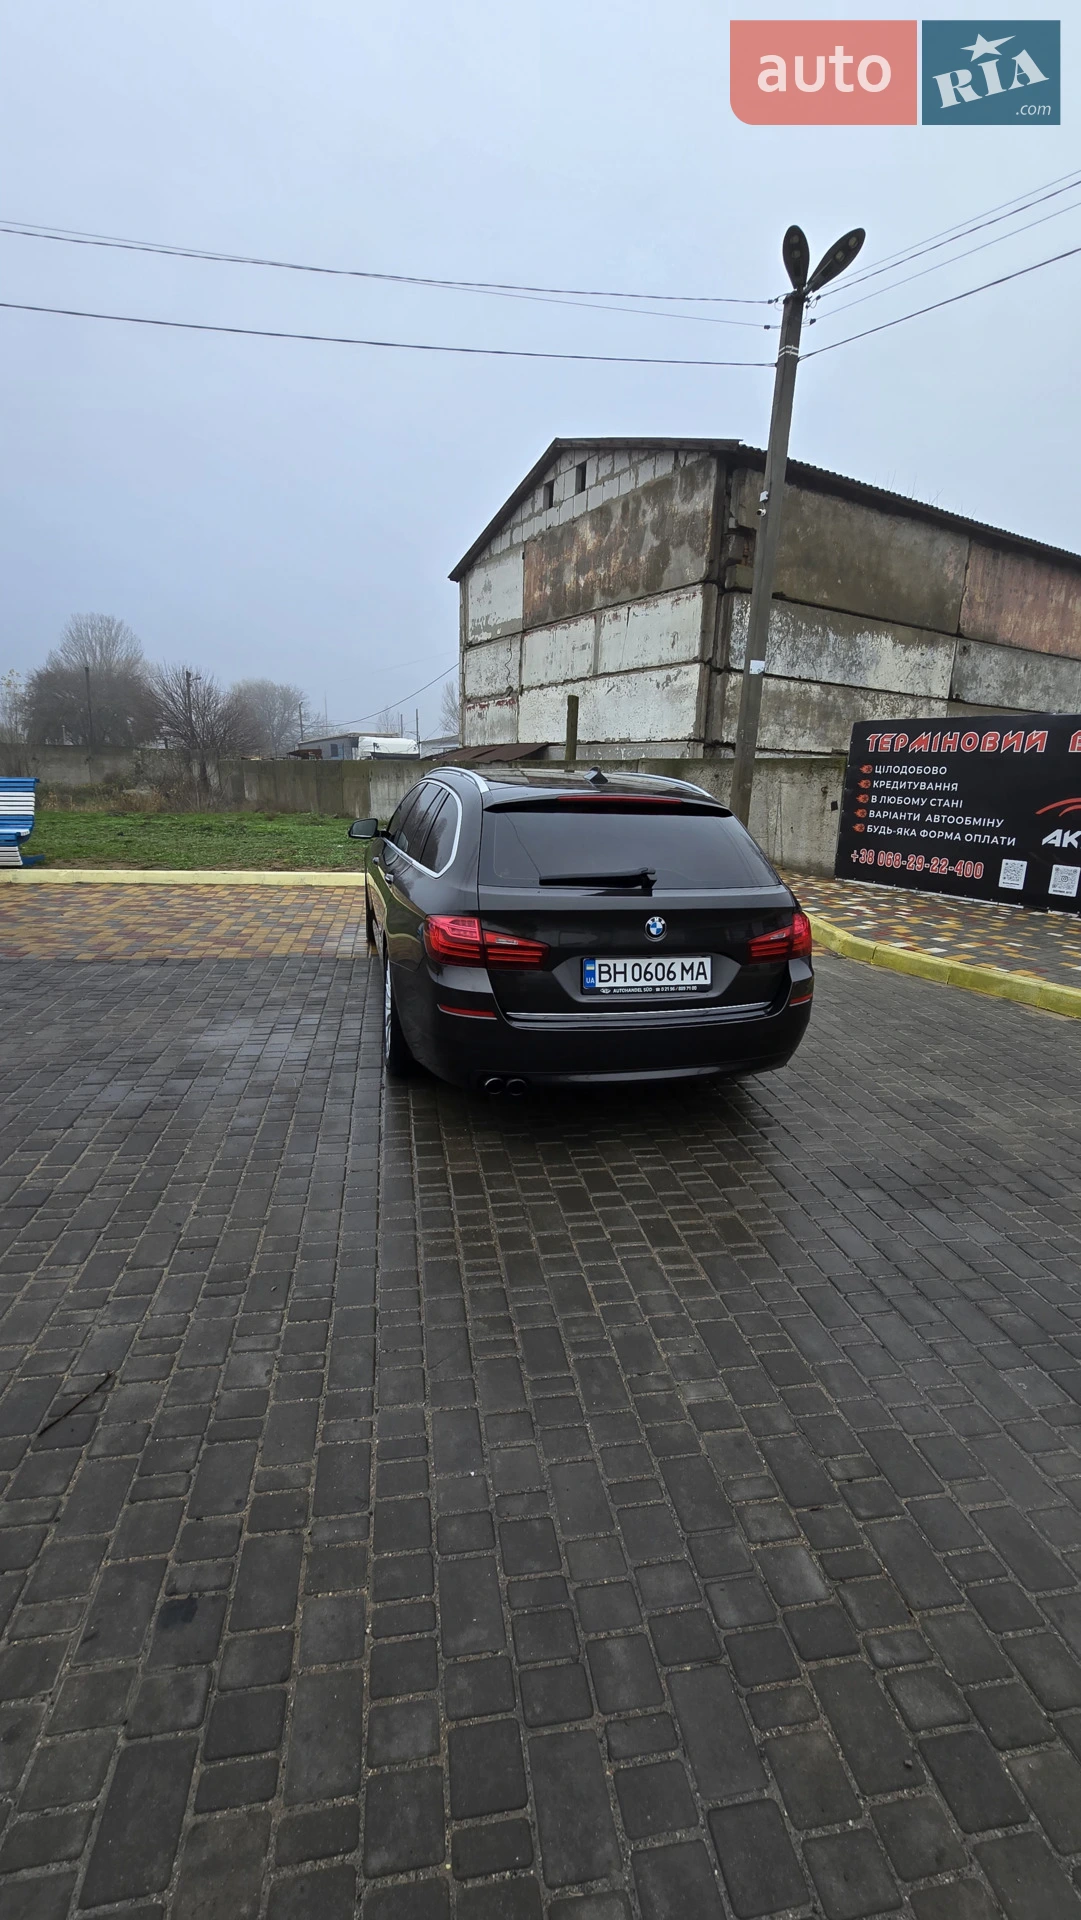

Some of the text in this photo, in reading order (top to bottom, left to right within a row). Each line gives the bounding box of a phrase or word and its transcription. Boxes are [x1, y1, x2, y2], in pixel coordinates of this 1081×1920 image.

[866, 730, 1048, 753] ТЕРМІНОВИЙ
[874, 765, 947, 775] ЦІЛОДОБОВО
[872, 780, 958, 792] КРЕДИТУВАННЯ
[871, 795, 963, 808] В ЛЮБОМУ СТАНІ
[869, 810, 1004, 828] ВАРІАНТИ АВТООБМІНУ
[866, 824, 1016, 846] БУДЬ-ЯКА ФОРМА ОПЛАТИ
[851, 848, 984, 879] +38 068-29-22-400
[598, 961, 708, 983] BH 0606 MA
